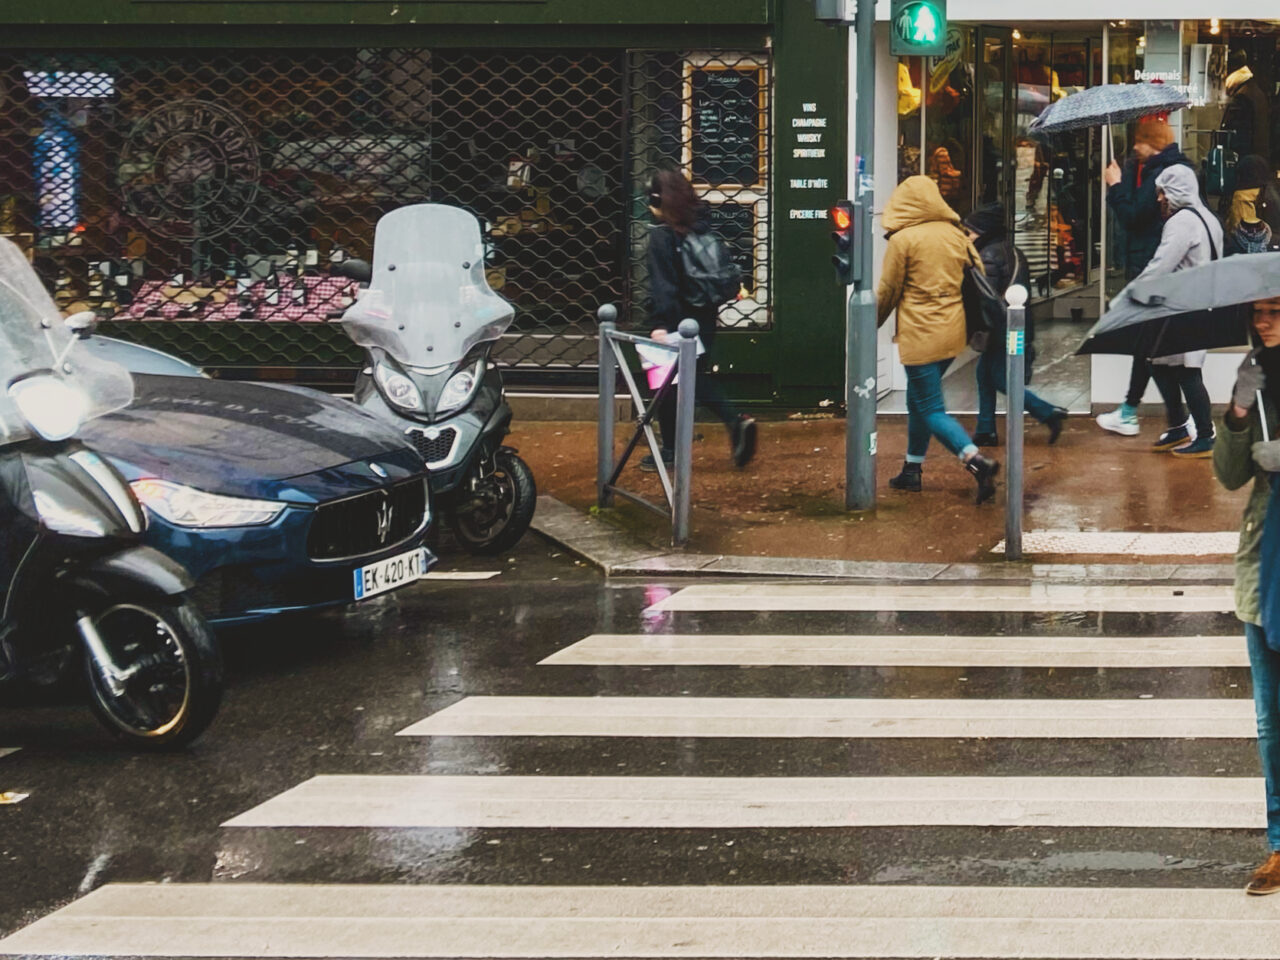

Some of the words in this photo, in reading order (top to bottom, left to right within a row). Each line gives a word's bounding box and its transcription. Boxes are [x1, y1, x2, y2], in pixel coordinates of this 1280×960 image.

[1134, 69, 1182, 81] Désormais
[802, 103, 817, 113] VINS
[792, 118, 827, 128] CHAMPAGNE
[796, 133, 822, 143] WHISKY
[790, 179, 807, 188] TABLE
[789, 208, 815, 219] ÉPICERIE
[815, 209, 828, 219] FINE
